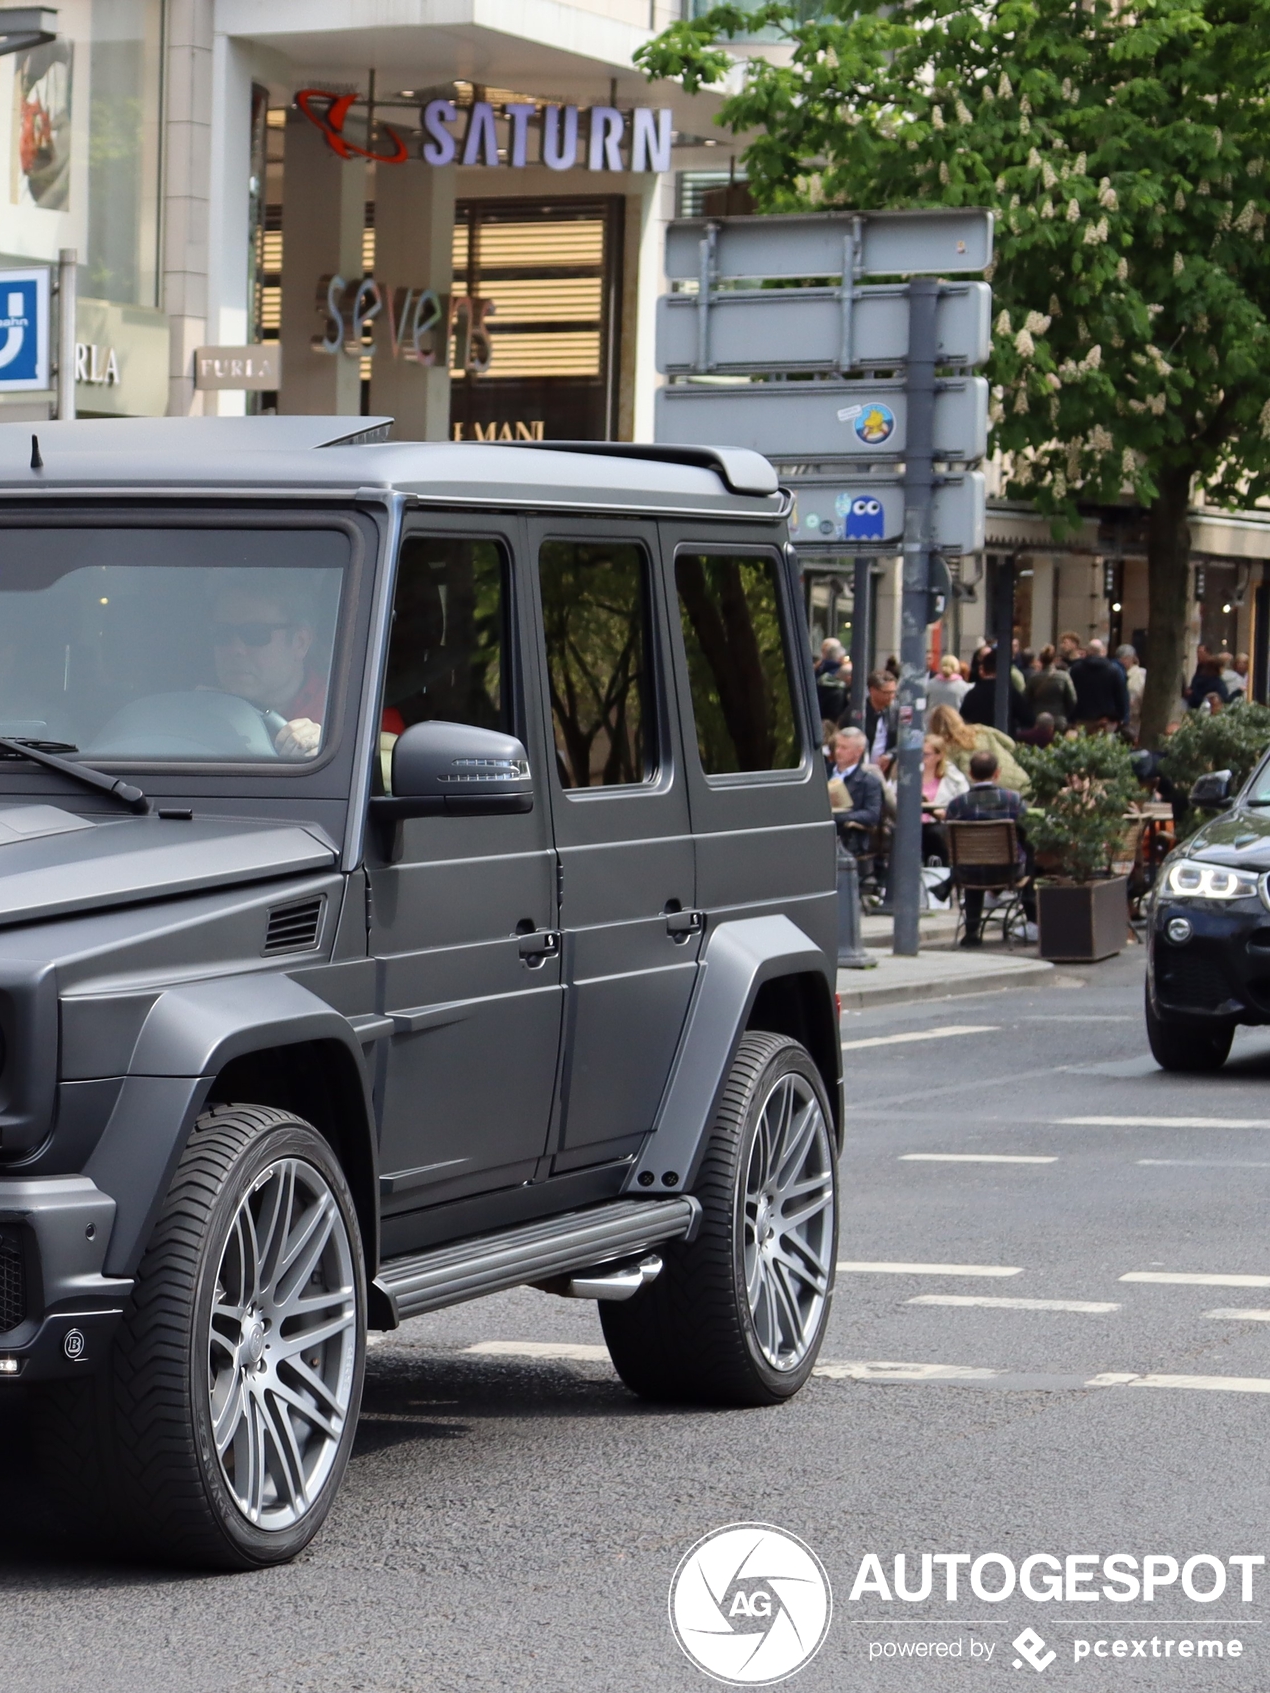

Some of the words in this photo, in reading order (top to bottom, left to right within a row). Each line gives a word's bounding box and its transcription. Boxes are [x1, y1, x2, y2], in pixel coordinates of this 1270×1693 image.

[422, 99, 672, 172] SATURN
[75, 342, 120, 384] RLA
[201, 359, 272, 378] FURLA
